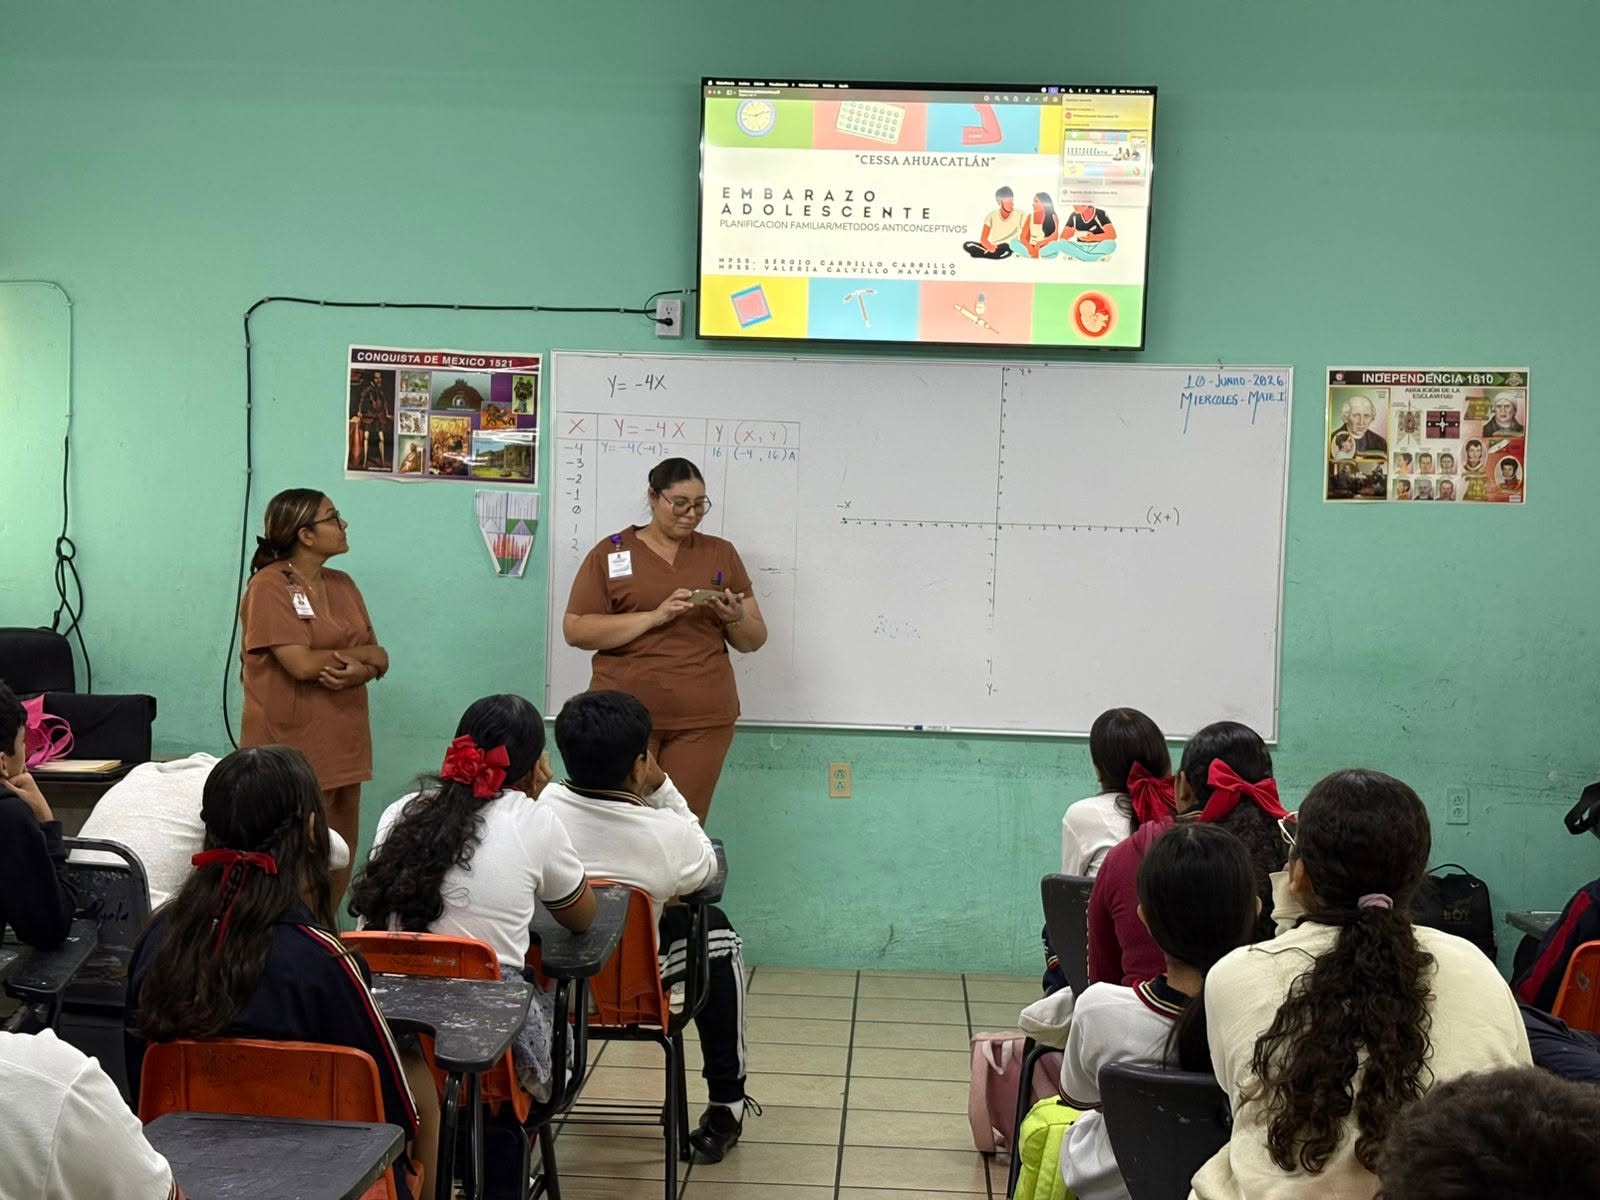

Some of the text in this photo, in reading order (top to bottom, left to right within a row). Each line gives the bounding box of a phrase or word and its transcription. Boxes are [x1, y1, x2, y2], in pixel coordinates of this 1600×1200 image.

[721, 187, 876, 202] EMBARAZO
[720, 202, 931, 219] ADOLESCENTE
[719, 219, 968, 234] PLANIFICACION FAMILIAR/METODOS ANTICONCEPTIVOS
[764, 258, 811, 266] SERGIO
[819, 259, 883, 268] CARRILLO
[891, 261, 956, 269] CARRILLO
[764, 265, 818, 273] VALERIA
[826, 266, 889, 274] CALVILLO
[897, 268, 957, 276] NAVARRO
[357, 351, 513, 368] CONQUISTA DE MEXICO 1521
[1252, 373, 1284, 386] 2026
[1362, 372, 1494, 385] INDEPENDENCIA 1810
[569, 418, 585, 434] X
[715, 424, 724, 442] Y
[564, 442, 583, 455] -4
[565, 458, 584, 468] -3
[566, 474, 583, 484] -2
[565, 488, 580, 501] -1
